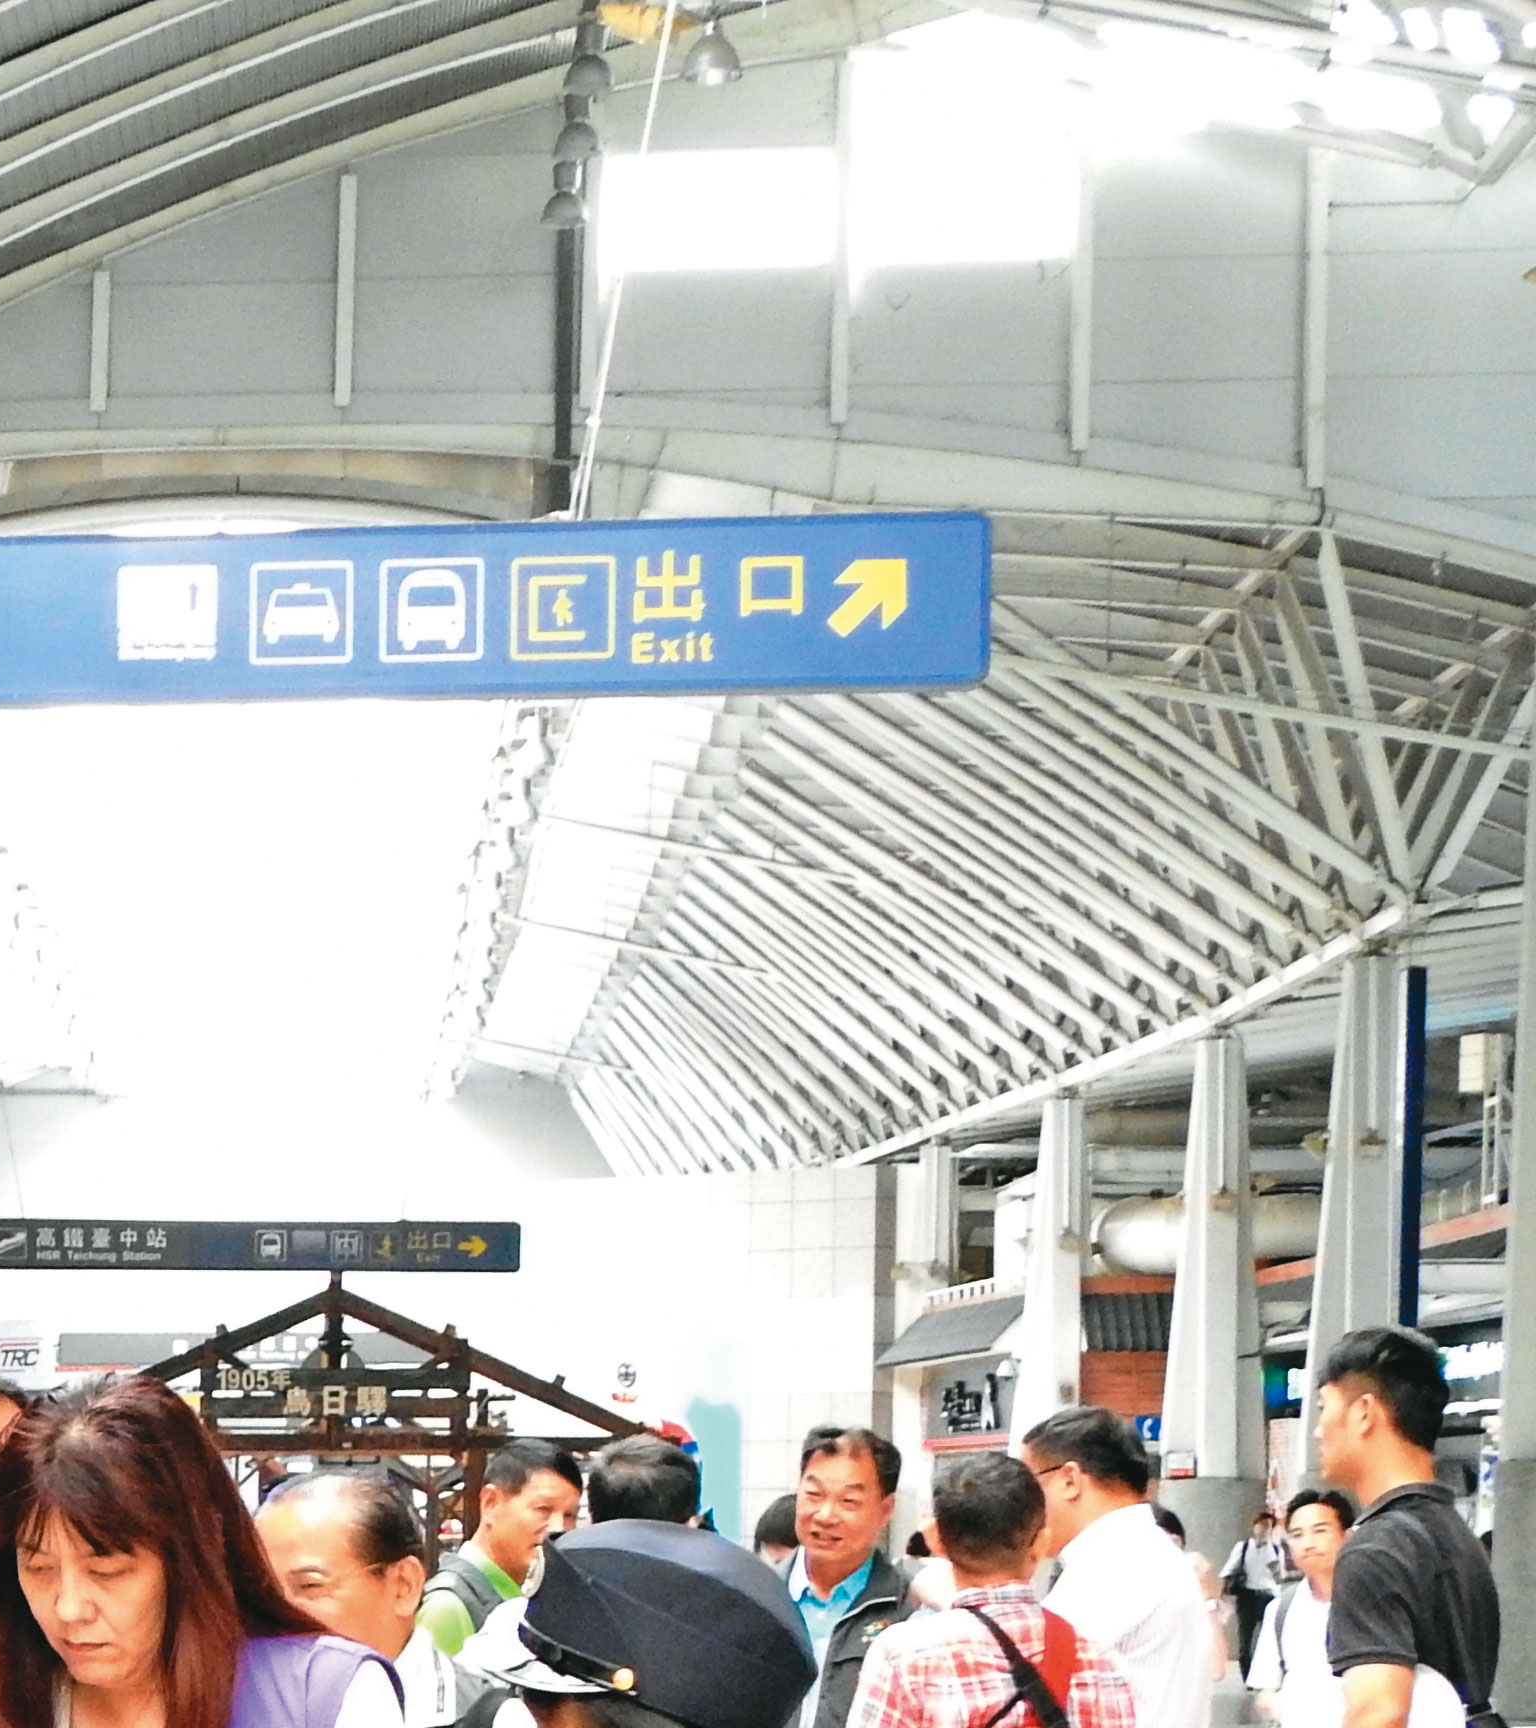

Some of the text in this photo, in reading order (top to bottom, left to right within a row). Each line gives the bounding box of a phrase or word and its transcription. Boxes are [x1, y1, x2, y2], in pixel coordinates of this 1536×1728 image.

[633, 549, 805, 622] 出口
[631, 630, 715, 664] Exit
[407, 1230, 451, 1250] 出口
[35, 1250, 161, 1263] HSR Taichung Station
[1, 1348, 40, 1367] TRC
[215, 1368, 292, 1391] 1905年
